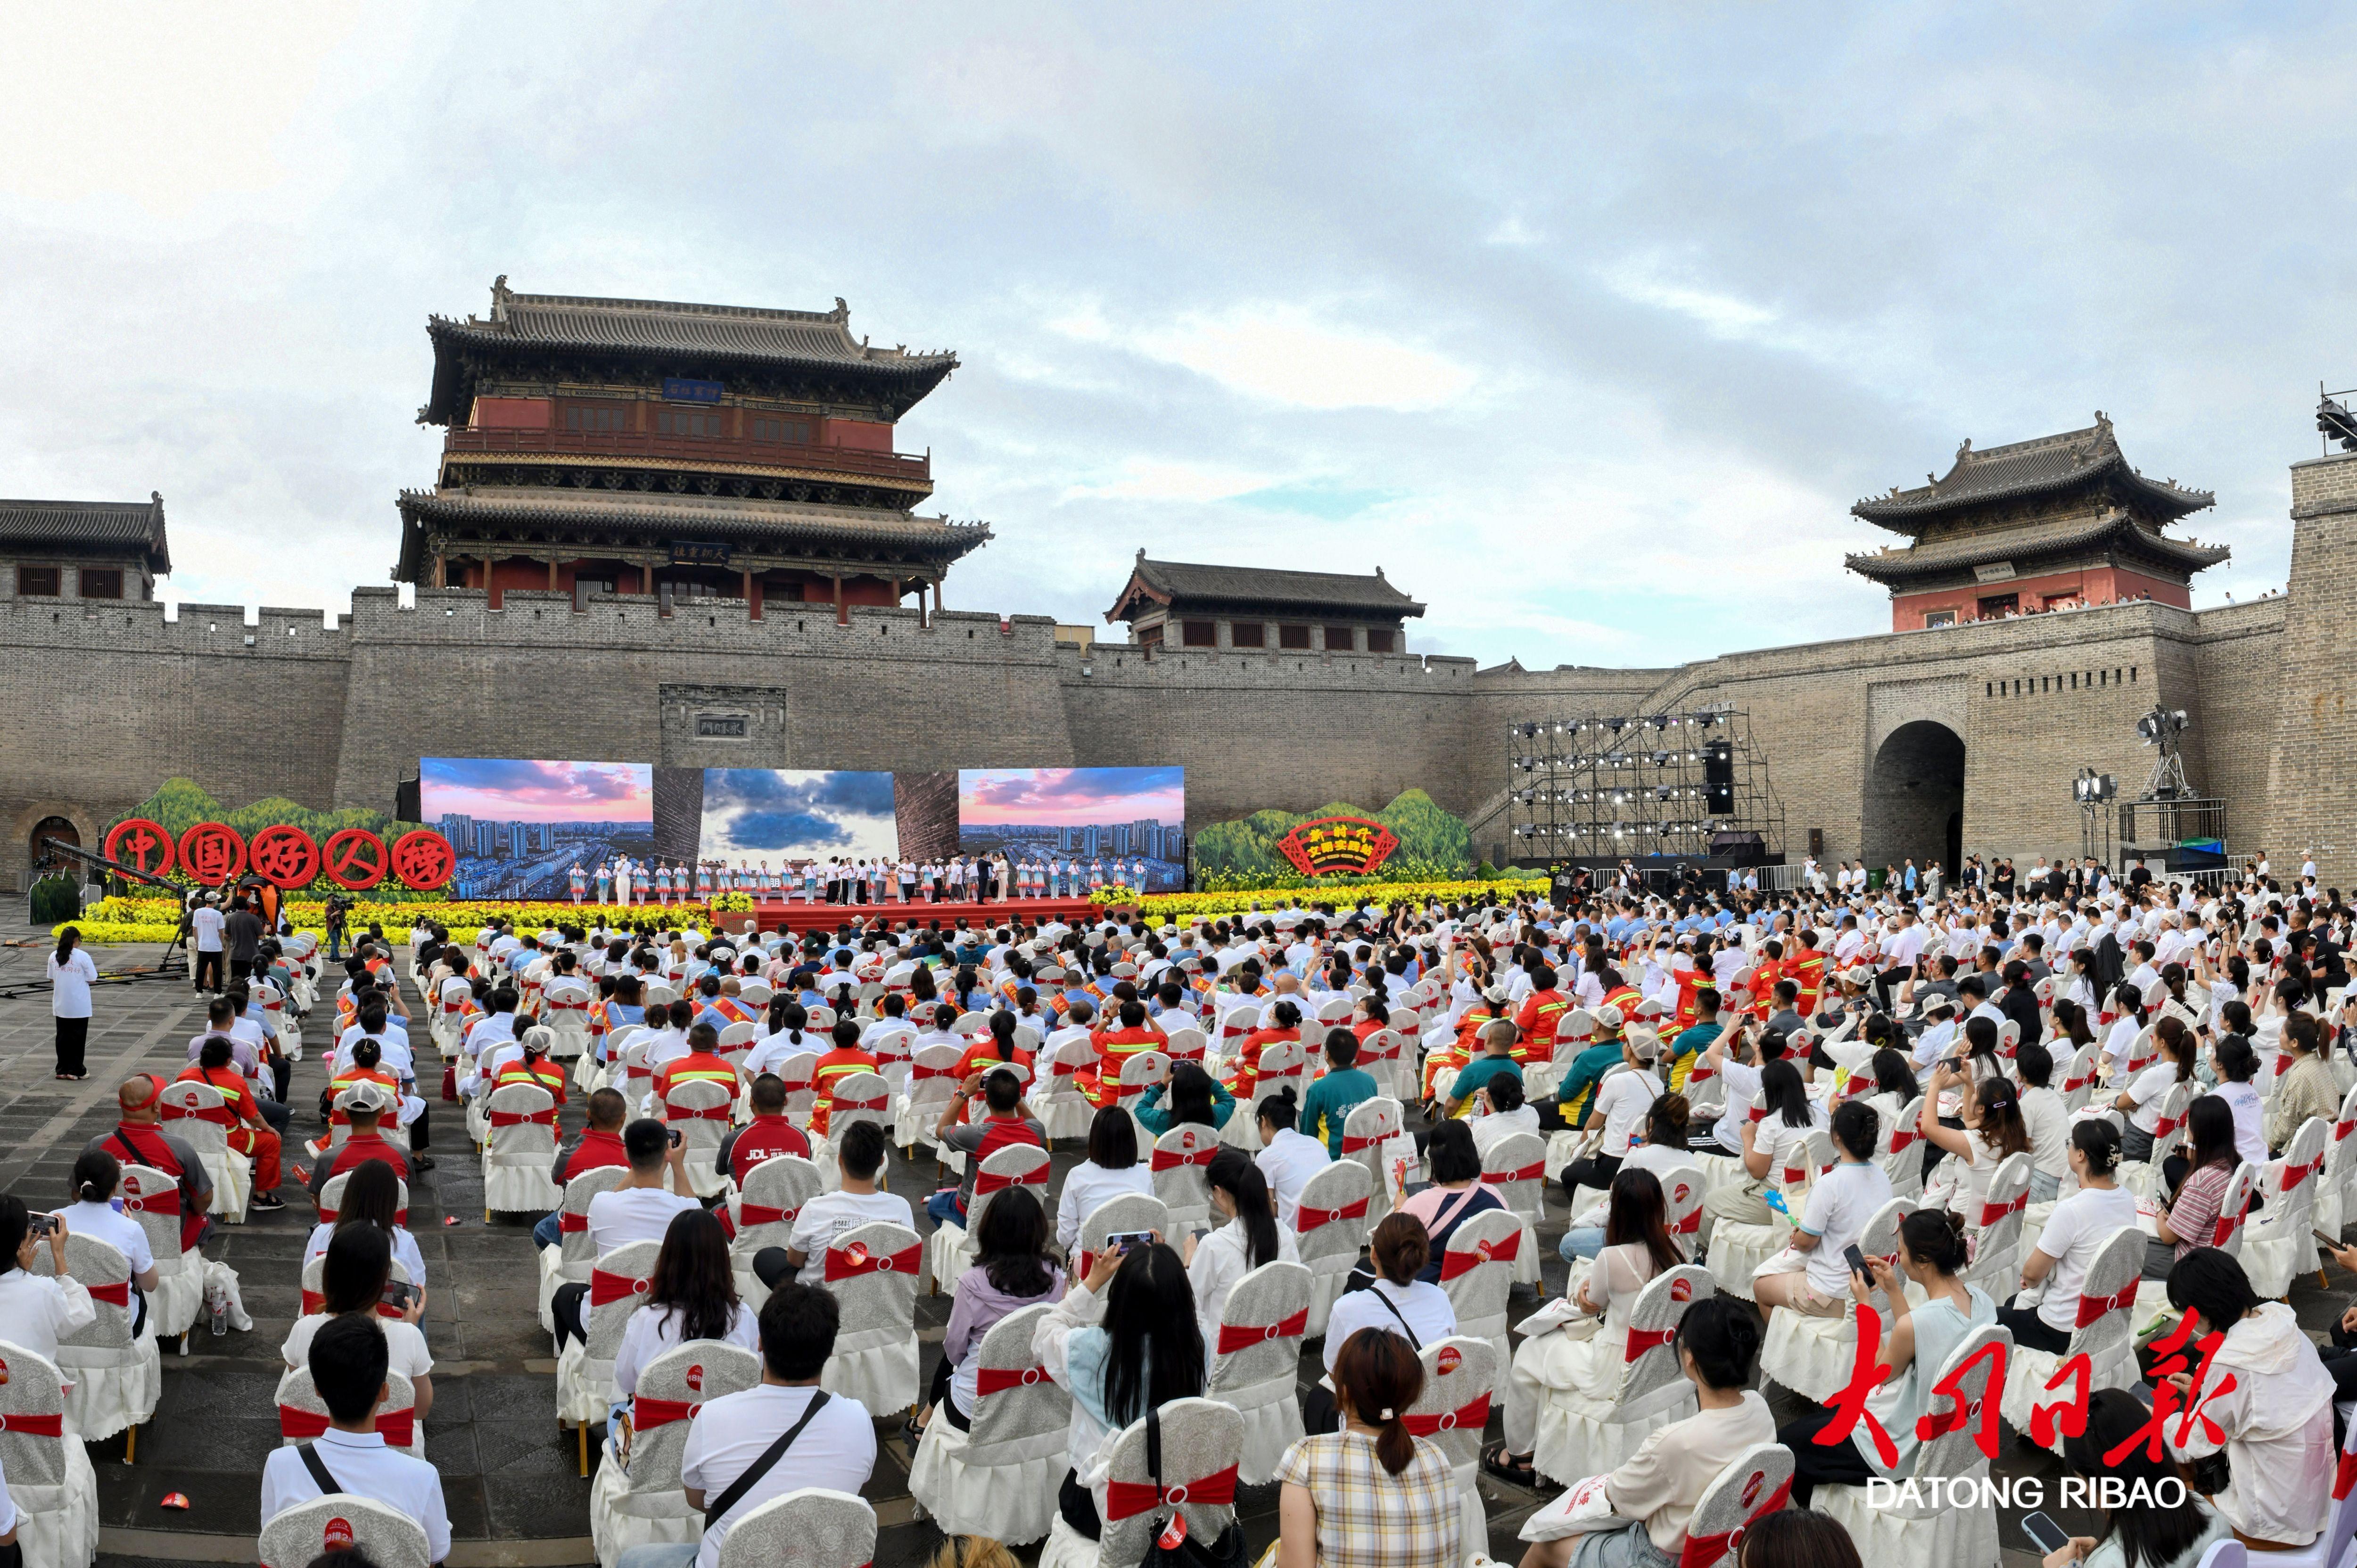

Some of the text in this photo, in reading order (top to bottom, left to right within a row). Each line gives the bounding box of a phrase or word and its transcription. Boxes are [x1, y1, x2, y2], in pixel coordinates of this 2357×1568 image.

[125, 828, 447, 883] 中国好人榜
[1307, 840, 1373, 858] 文明实践站
[745, 1149, 768, 1161] JDL
